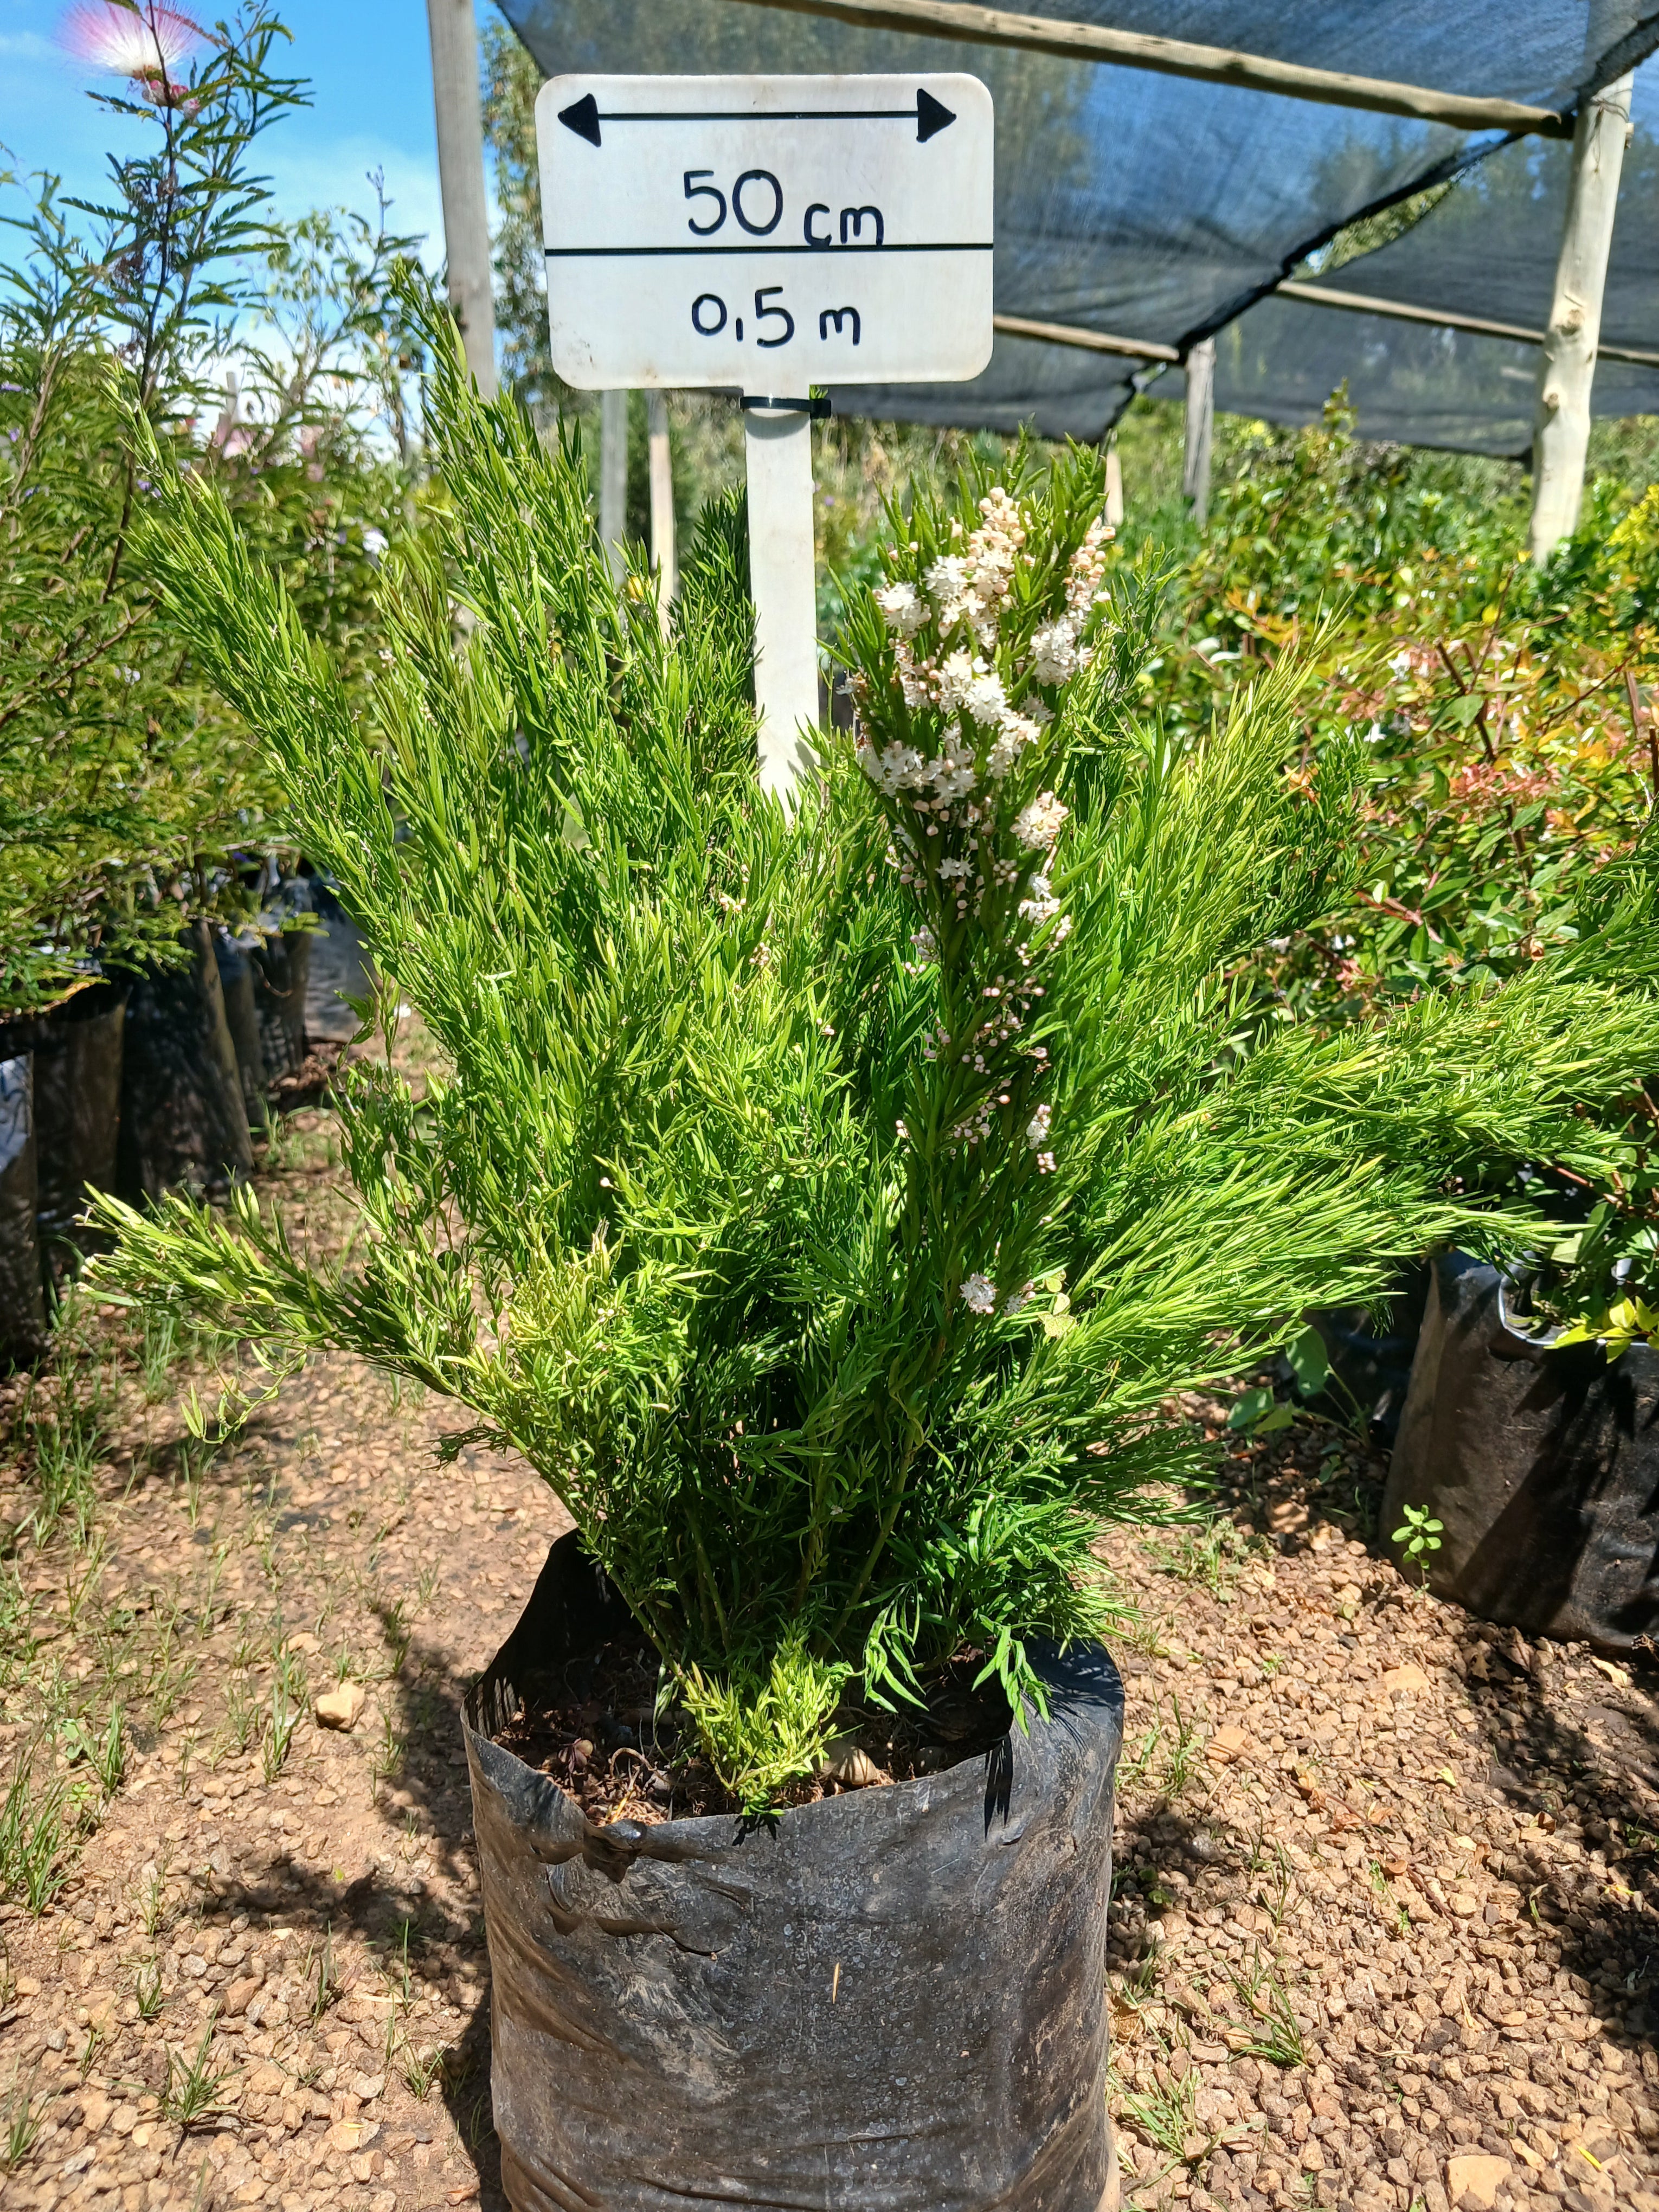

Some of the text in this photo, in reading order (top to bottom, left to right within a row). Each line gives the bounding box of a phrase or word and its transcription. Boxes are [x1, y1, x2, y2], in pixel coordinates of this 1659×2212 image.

[683, 169, 885, 247] 50 cm
[691, 286, 861, 348] 0,5 m
